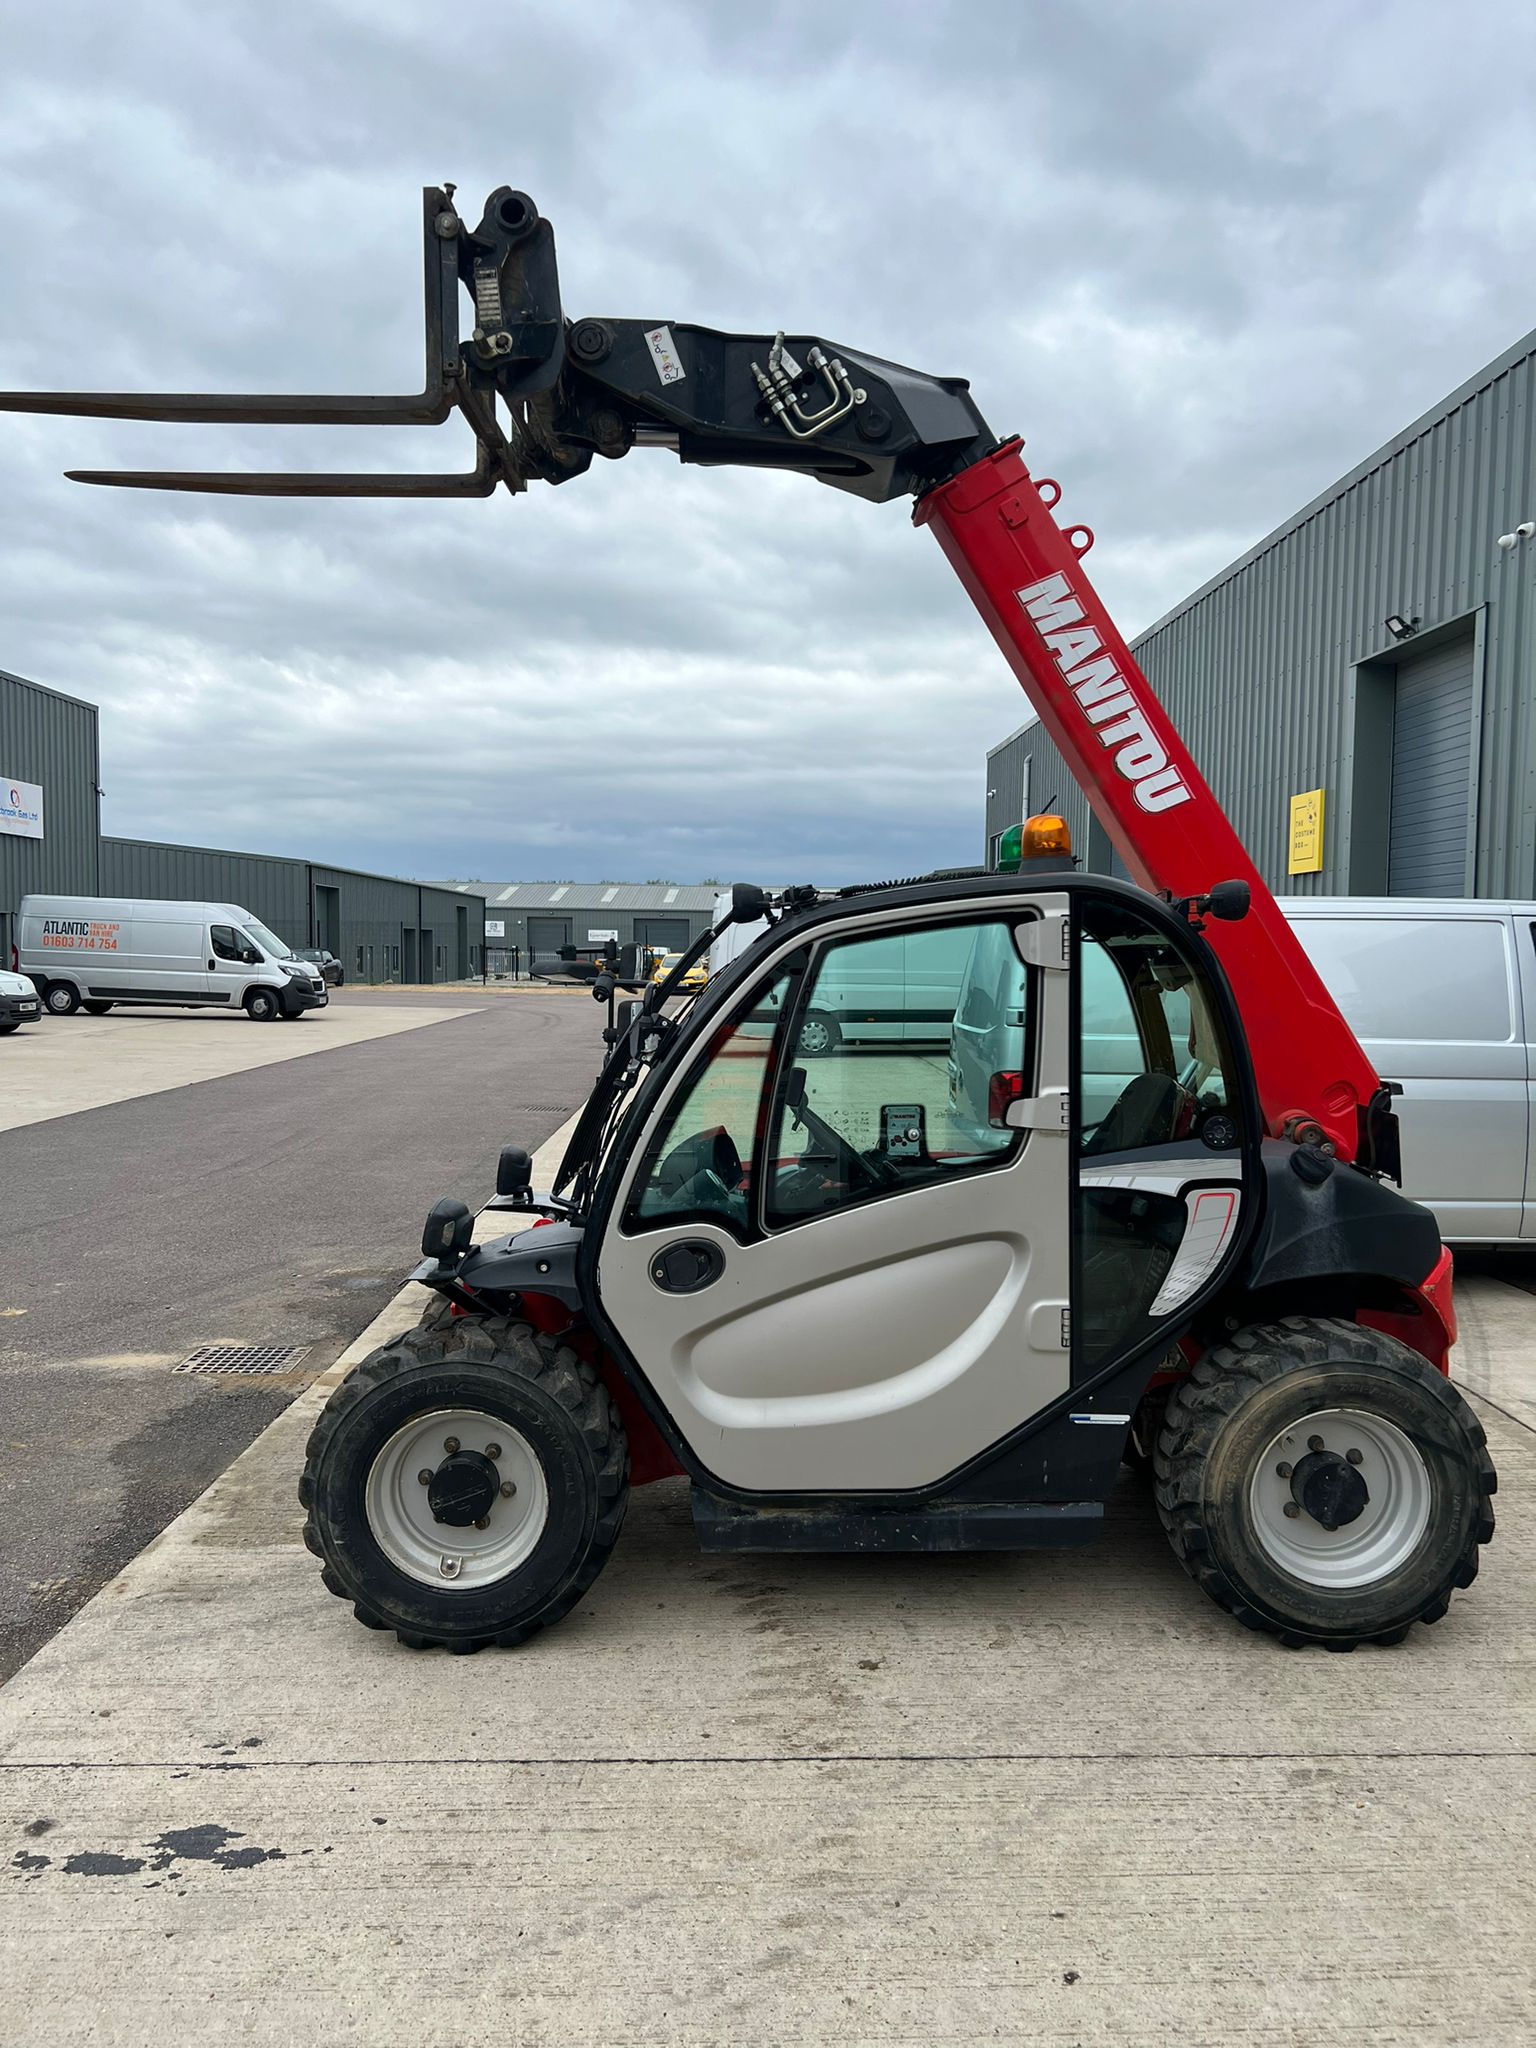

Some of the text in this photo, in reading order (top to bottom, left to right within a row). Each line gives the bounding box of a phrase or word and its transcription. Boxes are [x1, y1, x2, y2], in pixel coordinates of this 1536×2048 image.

[1015, 572, 1191, 813] MANITOU
[29, 811, 38, 820] Ltd
[43, 920, 89, 936] ATLANTIC
[90, 922, 120, 931] TRUCK AND
[43, 935, 117, 950] 01603 714 754
